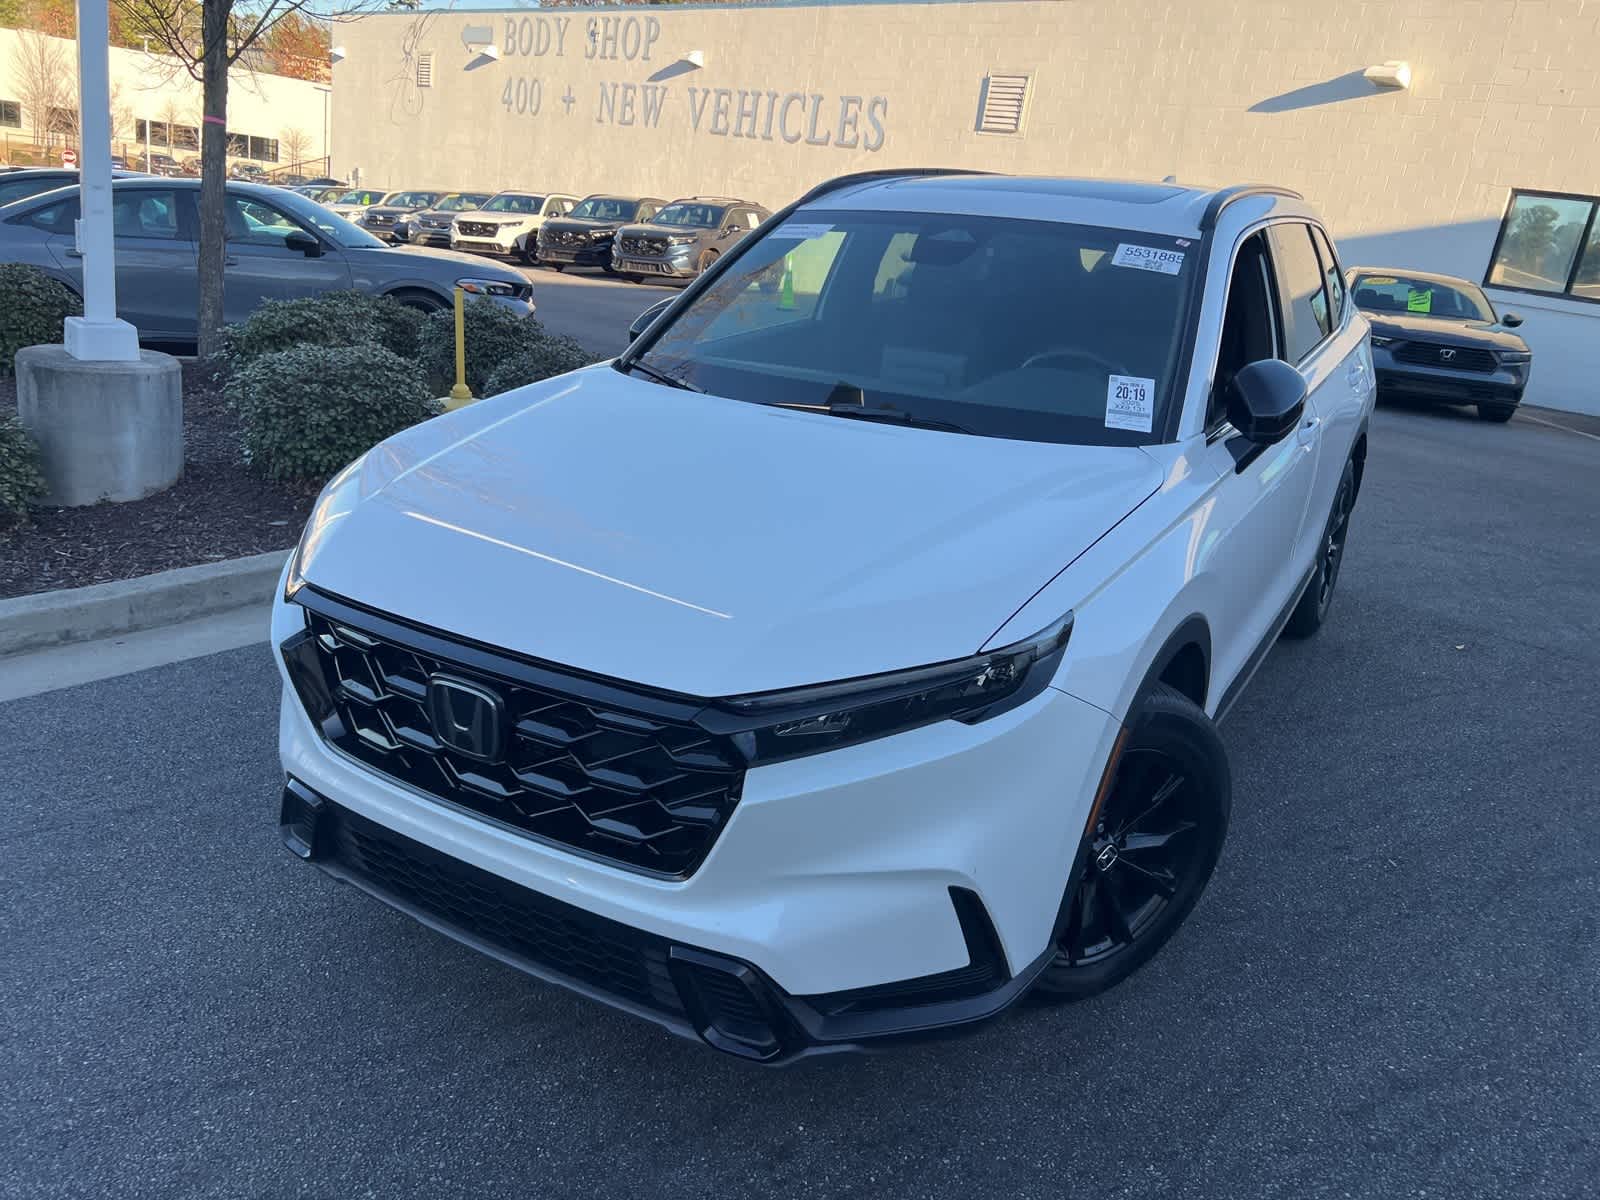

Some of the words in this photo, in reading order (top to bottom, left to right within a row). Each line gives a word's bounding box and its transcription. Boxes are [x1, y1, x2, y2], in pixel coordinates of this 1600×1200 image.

[503, 16, 571, 57] BODY
[585, 15, 661, 61] SHOP
[501, 76, 542, 117] 400
[596, 82, 668, 129] NEW
[687, 86, 889, 153] VEHICLES
[1115, 385, 1147, 402] 20:19
